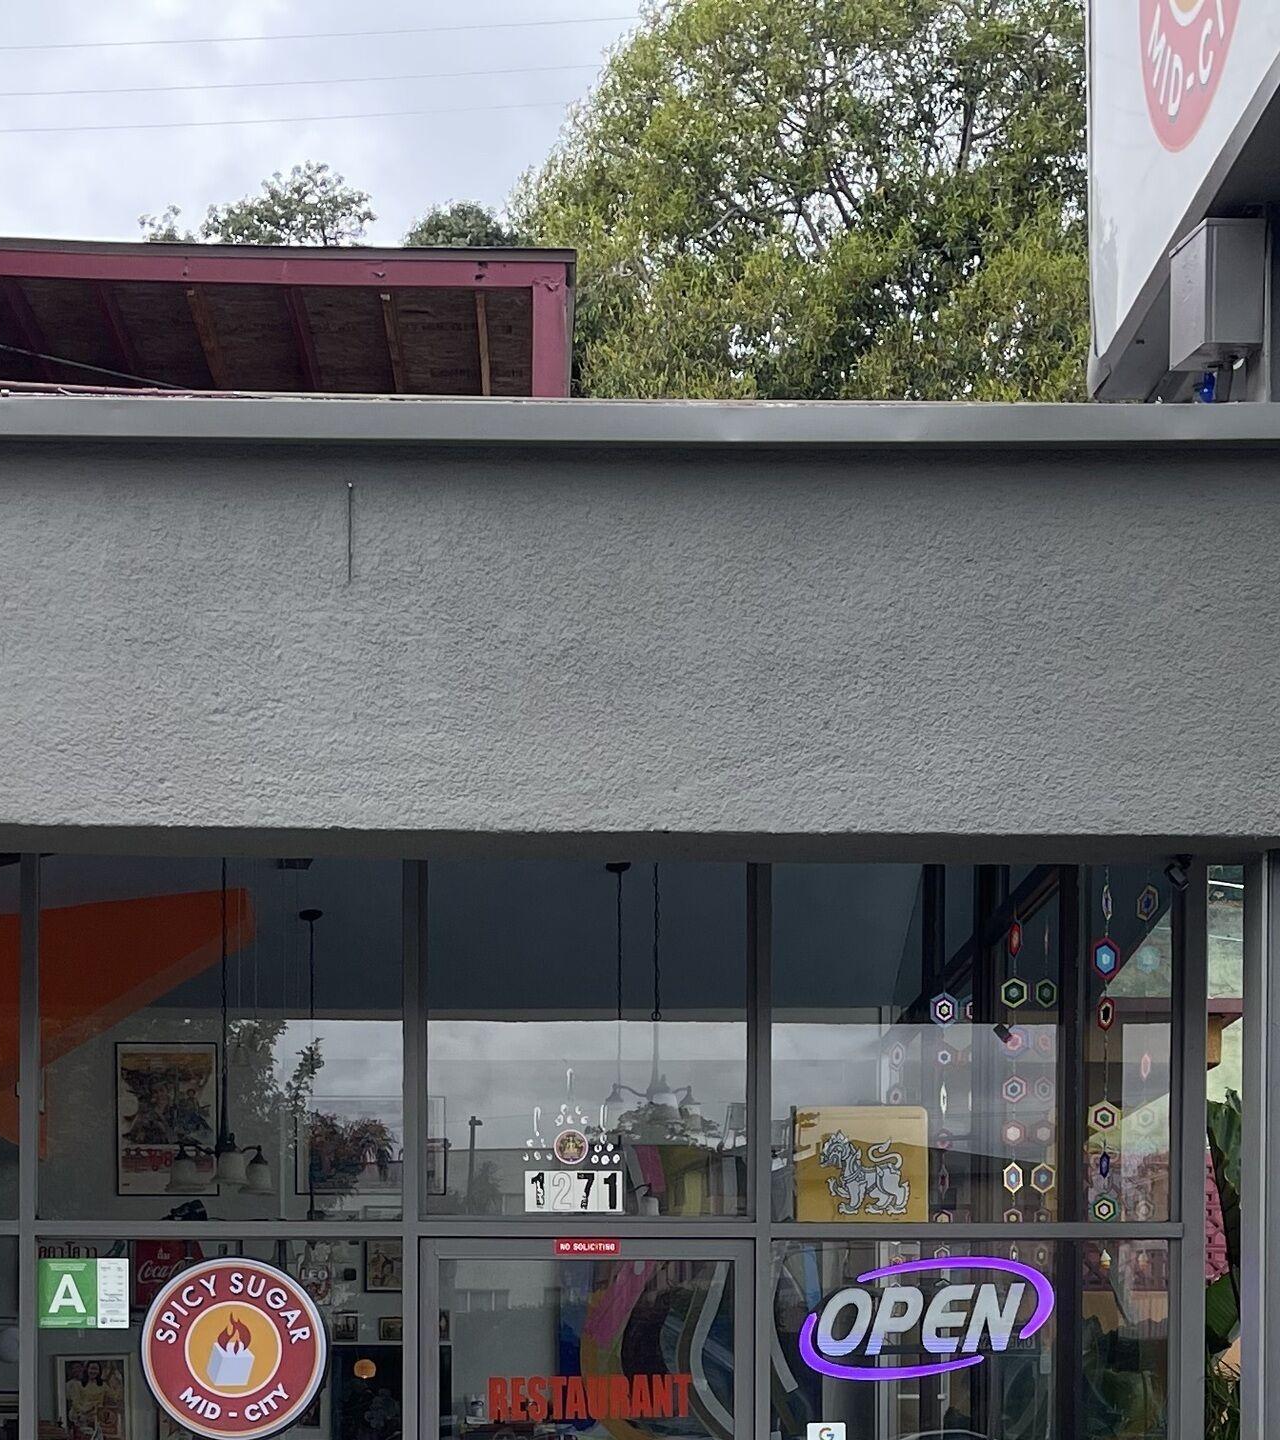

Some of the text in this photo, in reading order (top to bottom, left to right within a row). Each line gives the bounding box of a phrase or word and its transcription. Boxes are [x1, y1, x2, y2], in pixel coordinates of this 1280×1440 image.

[531, 1171, 618, 1211] 1271
[560, 1243, 616, 1251] NO SOLICITING
[48, 1273, 87, 1314] A
[301, 1269, 329, 1281] LEO
[155, 1274, 218, 1345] SPICY
[229, 1272, 311, 1345] SUGAR
[816, 1282, 1027, 1357] OPEN
[488, 1374, 693, 1422] RESTAURANT
